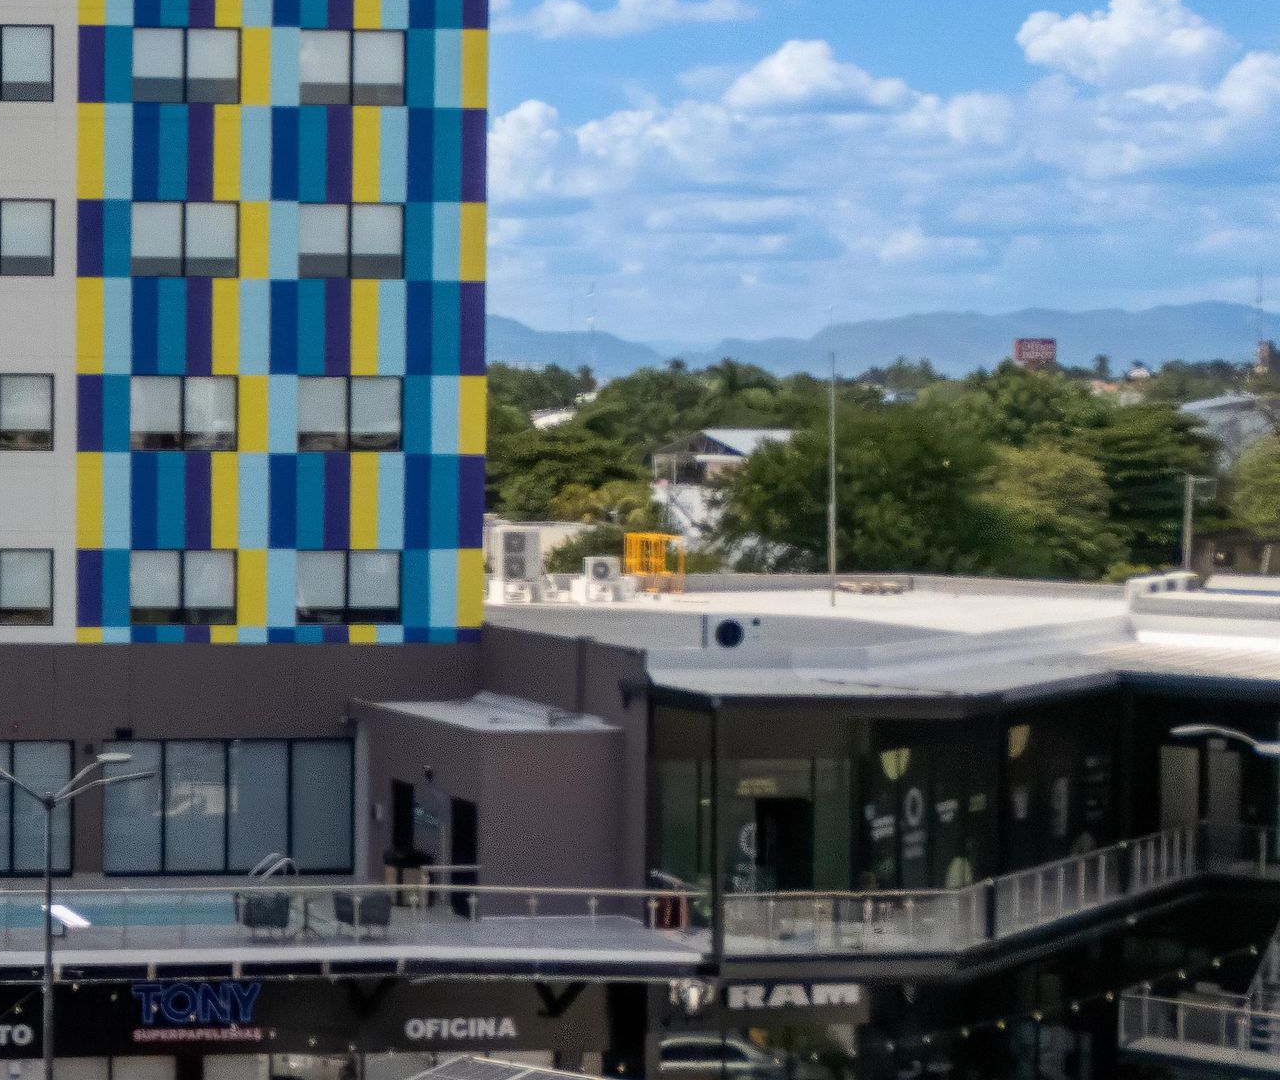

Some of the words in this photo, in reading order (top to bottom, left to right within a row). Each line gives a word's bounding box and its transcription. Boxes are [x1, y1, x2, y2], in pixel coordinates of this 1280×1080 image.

[131, 982, 262, 1024] TONY
[726, 983, 861, 1009] RAM
[404, 1017, 518, 1040] OFICINA
